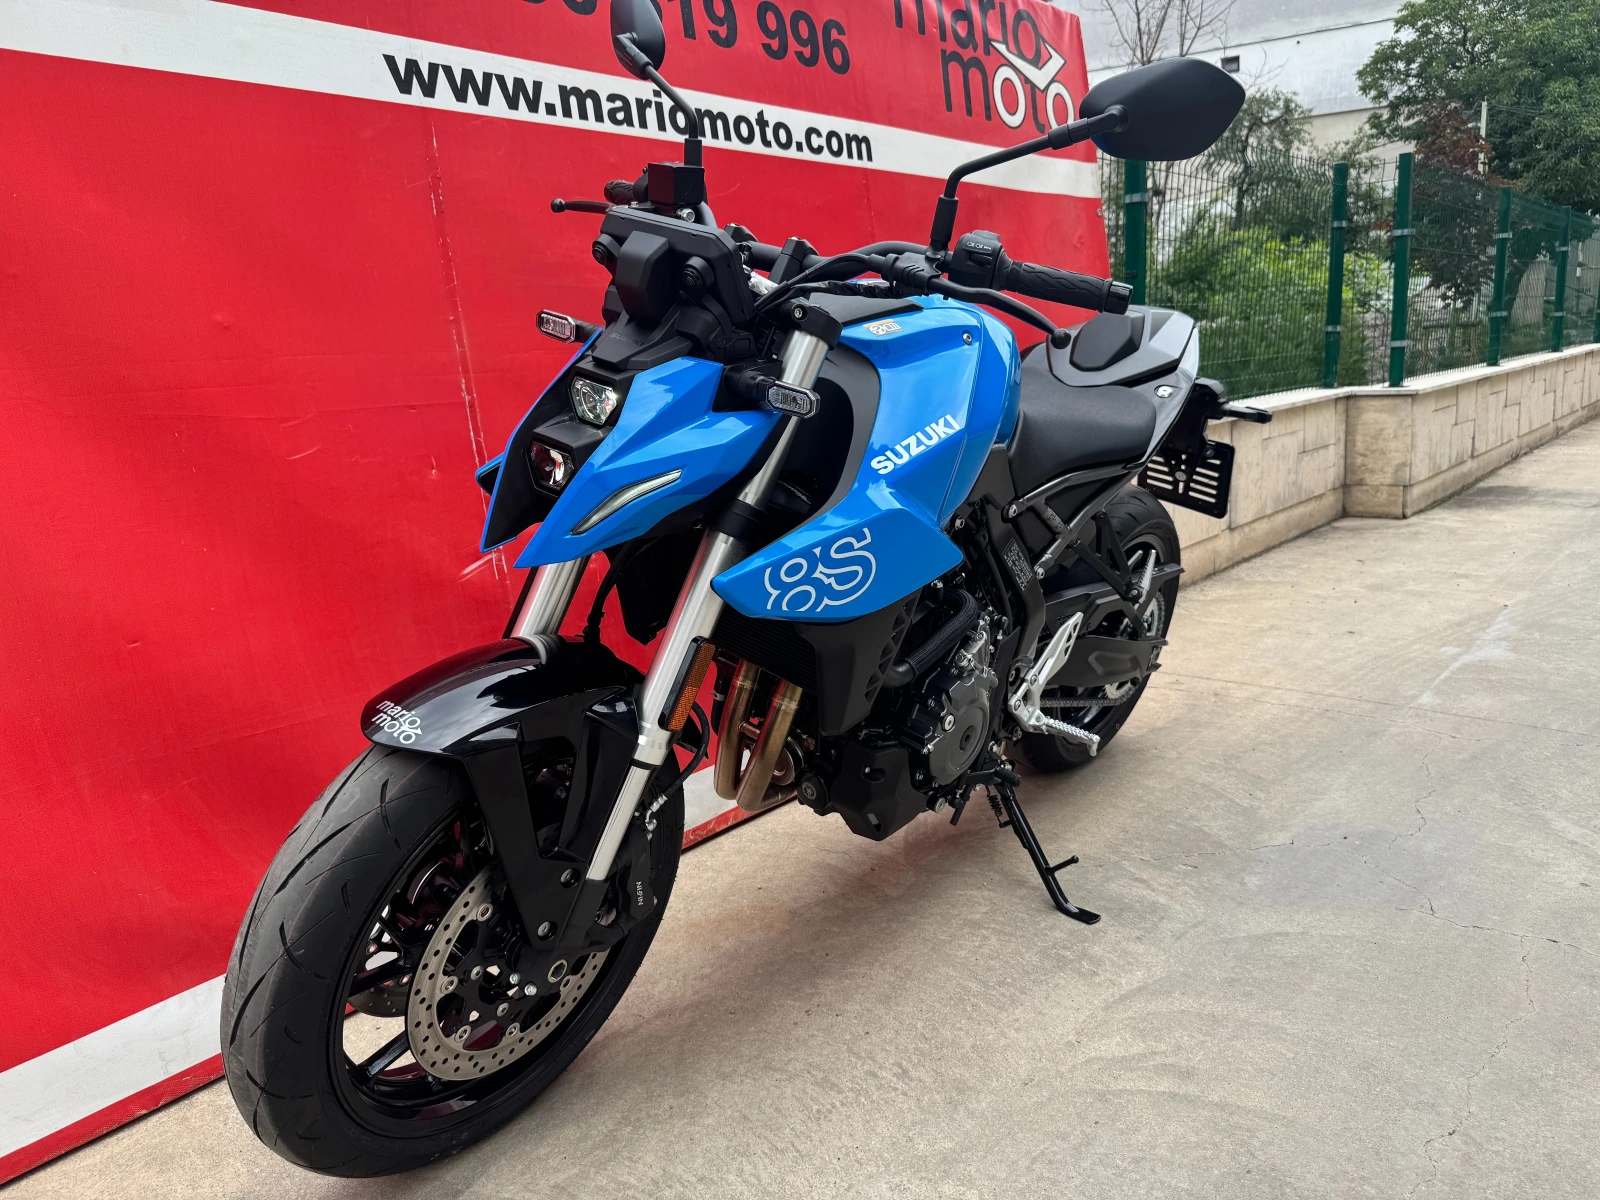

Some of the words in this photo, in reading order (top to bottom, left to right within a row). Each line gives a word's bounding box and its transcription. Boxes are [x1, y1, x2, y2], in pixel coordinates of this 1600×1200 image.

[650, 0, 738, 48] 19
[757, 1, 850, 75] 996
[383, 54, 873, 162] www.mariomoto.com
[941, 49, 1076, 134] moto
[871, 413, 963, 475] SUZUKI
[371, 713, 416, 744] moto
[375, 701, 420, 728] mario
